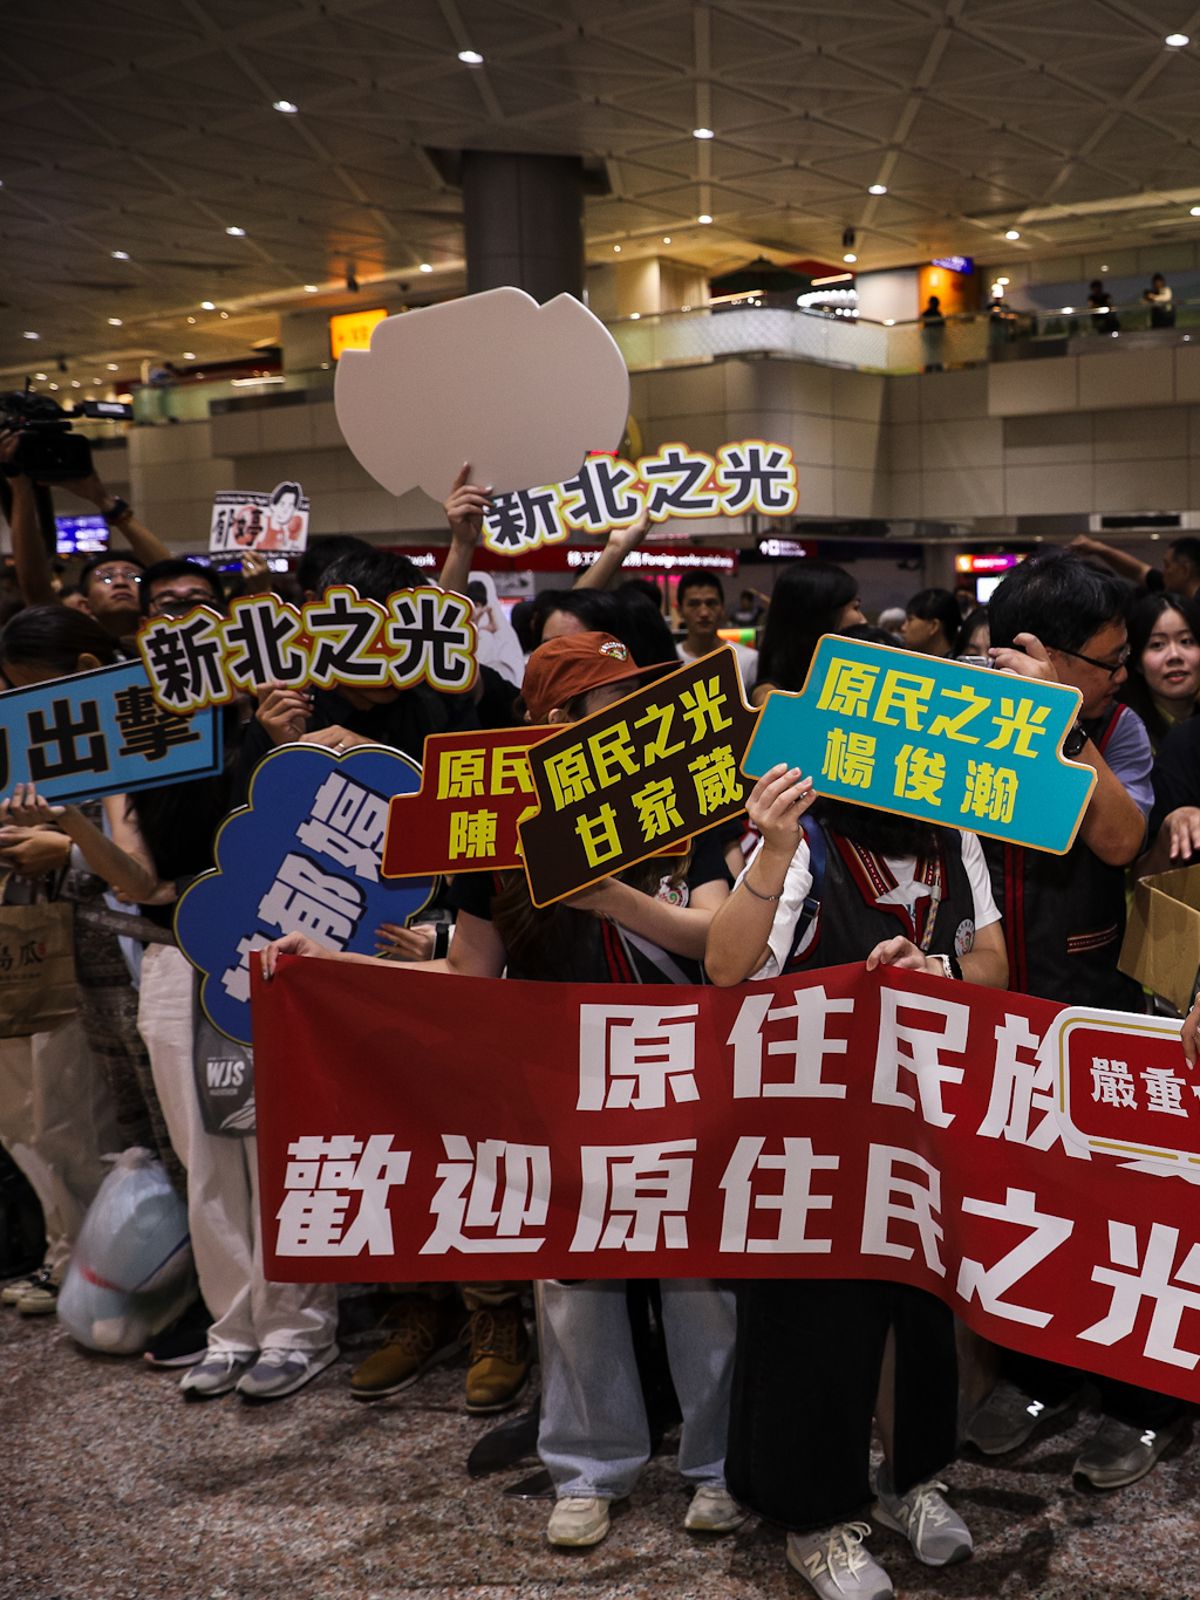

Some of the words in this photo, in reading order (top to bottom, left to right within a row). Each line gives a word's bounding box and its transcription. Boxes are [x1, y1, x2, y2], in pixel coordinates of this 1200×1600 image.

[485, 446, 792, 548] 新北之光
[144, 591, 476, 704] 新北之光
[0, 686, 200, 786] 出擊
[543, 674, 733, 812] 原民之光
[815, 657, 1052, 760] 原民之光
[574, 745, 744, 868] 甘家葳
[821, 728, 1019, 825] 楊俊瀚
[207, 1061, 245, 1087] WJS
